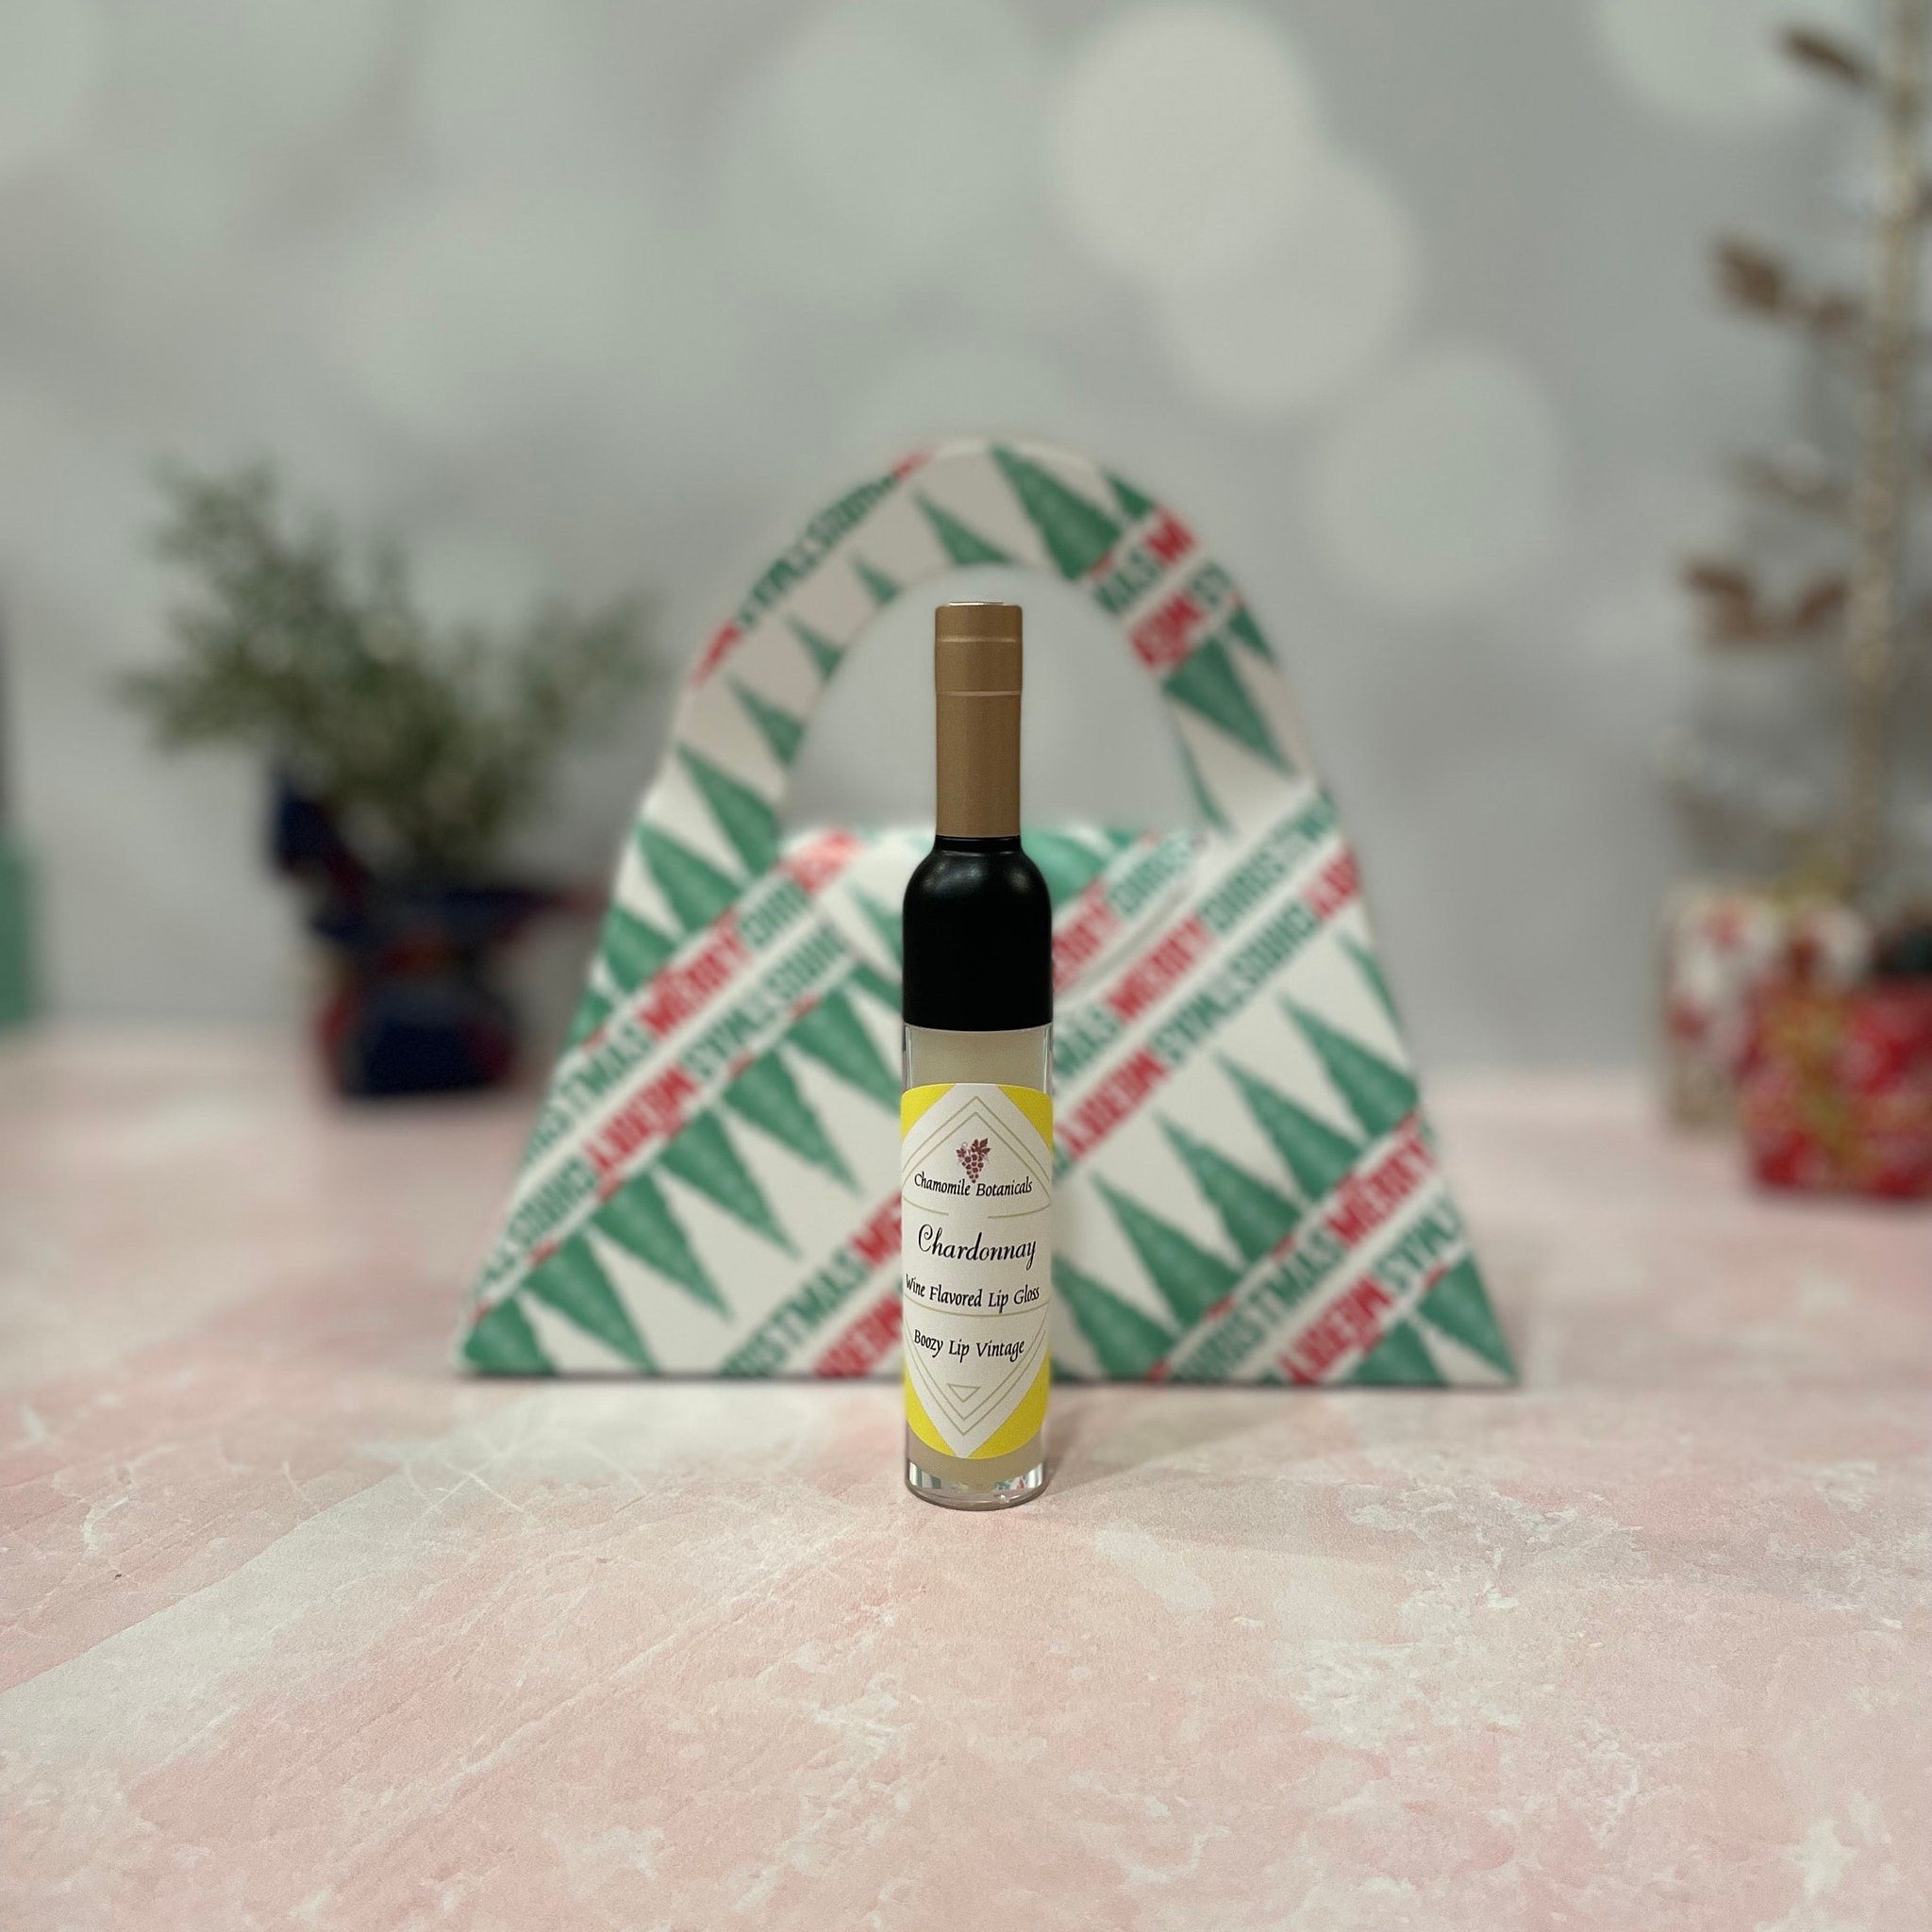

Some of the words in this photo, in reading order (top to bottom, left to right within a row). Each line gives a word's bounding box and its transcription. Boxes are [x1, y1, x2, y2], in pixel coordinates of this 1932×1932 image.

[914, 1171, 971, 1196] Chamomile
[975, 1175, 1033, 1196] Botanicals
[918, 1224, 1037, 1271] Chardonnay
[906, 1274, 925, 1297] Wine
[929, 1284, 982, 1307] Flavored
[988, 1290, 1008, 1313] Lip
[1013, 1284, 1040, 1305] Gloss
[914, 1329, 943, 1357] Boozy
[948, 1339, 970, 1363] Lip
[975, 1340, 1024, 1362] Vintage
